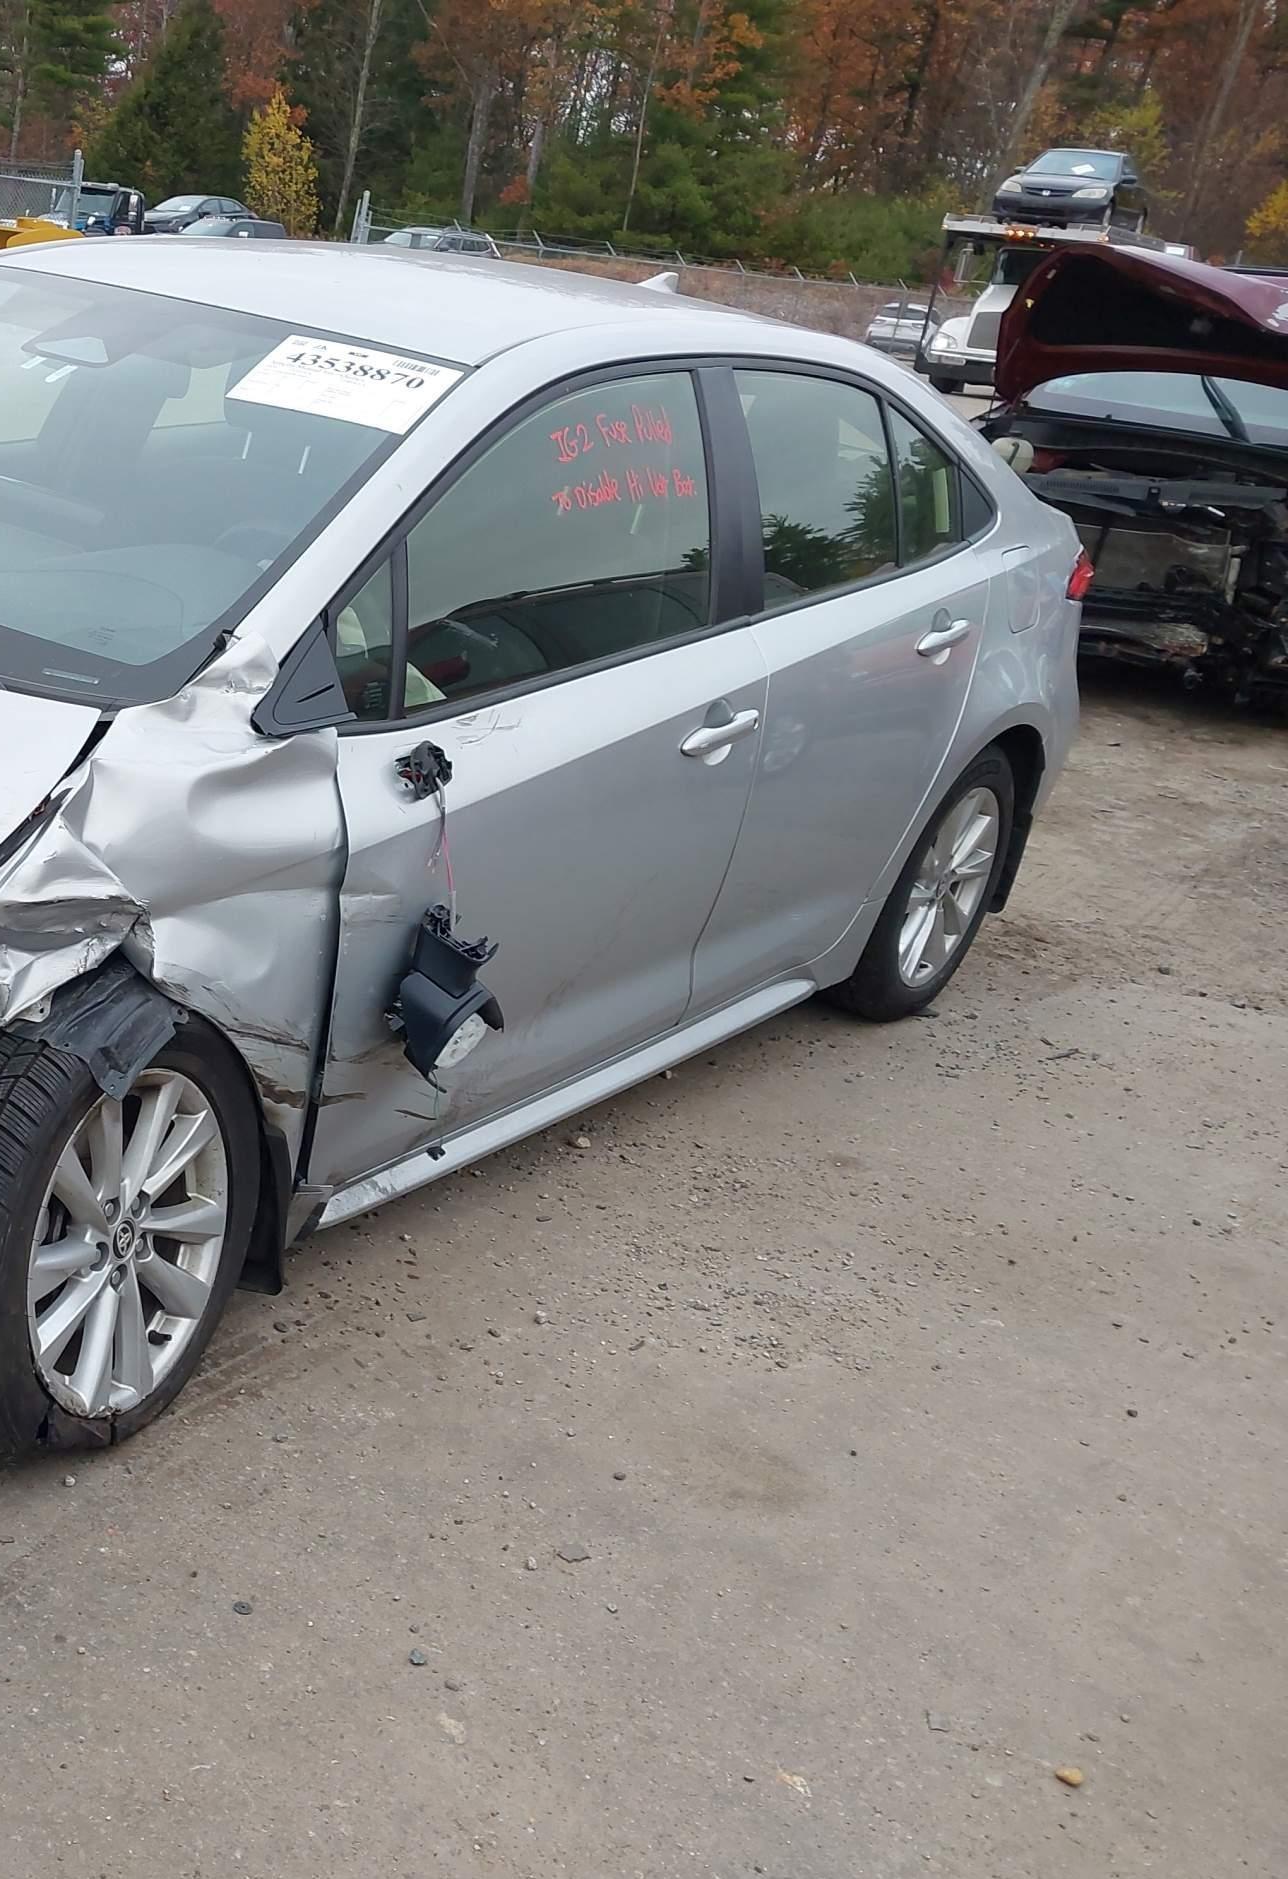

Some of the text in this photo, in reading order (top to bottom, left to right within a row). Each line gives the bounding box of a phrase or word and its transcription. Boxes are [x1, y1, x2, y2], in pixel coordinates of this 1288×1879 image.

[286, 352, 425, 389] 43538870
[595, 414, 632, 448] Fuse
[574, 471, 621, 509] Disable
